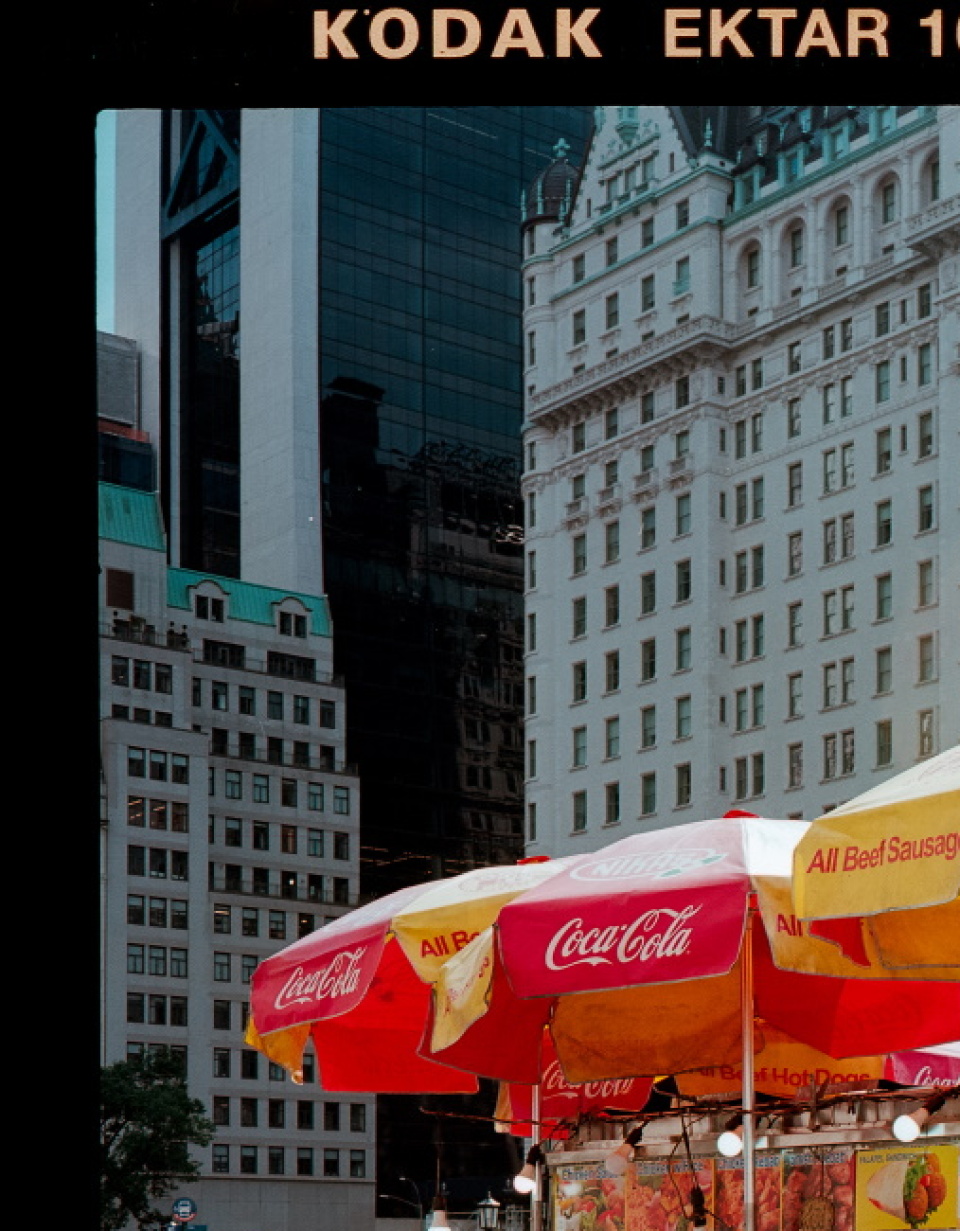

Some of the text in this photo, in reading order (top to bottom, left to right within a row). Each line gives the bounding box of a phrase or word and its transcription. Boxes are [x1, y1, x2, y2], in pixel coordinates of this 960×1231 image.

[806, 847, 839, 874] All
[842, 838, 886, 873] Beef
[420, 935, 449, 959] All
[544, 903, 704, 972] Coca-Cola
[274, 946, 369, 1010] Coca-Cola
